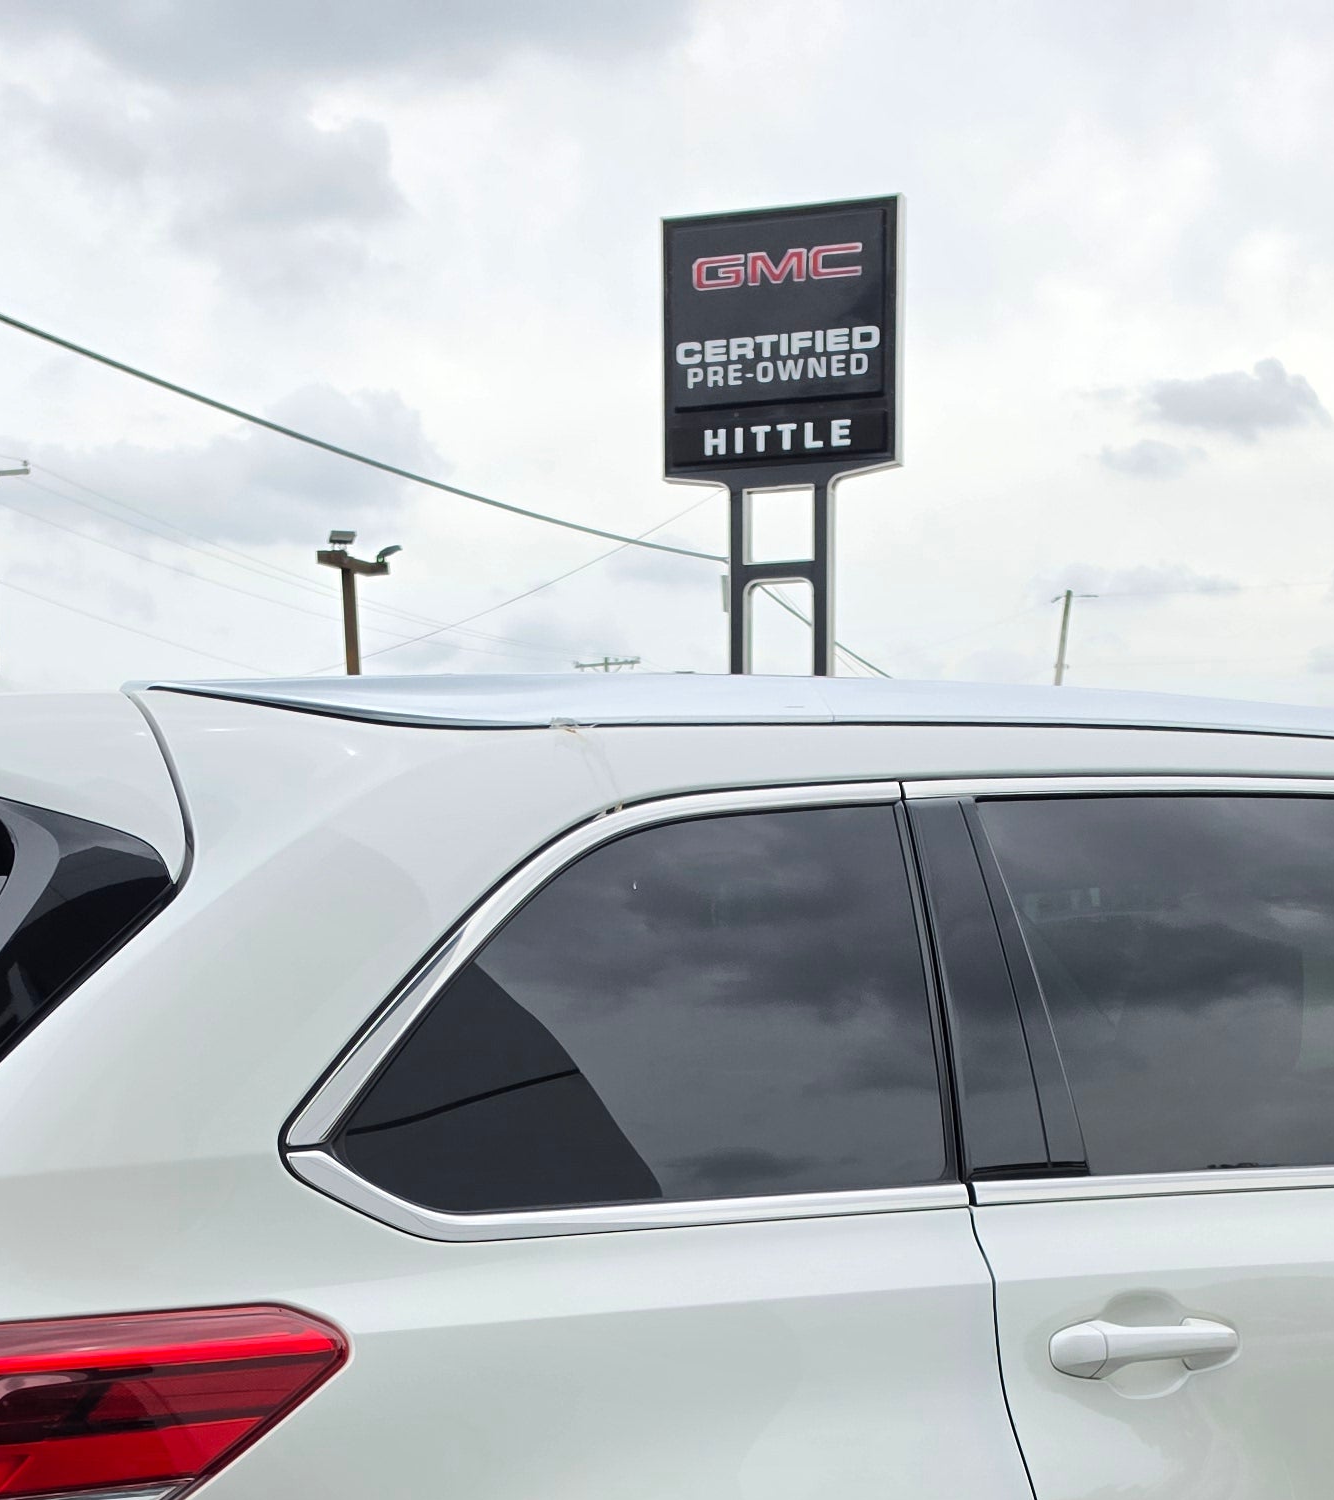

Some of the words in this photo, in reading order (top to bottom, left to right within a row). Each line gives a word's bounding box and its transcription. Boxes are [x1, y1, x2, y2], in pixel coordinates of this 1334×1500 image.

[691, 241, 863, 292] GMC
[675, 325, 881, 366] CERTIFIED
[687, 352, 870, 390] PRE-OWNED
[703, 418, 853, 457] HITTLE
